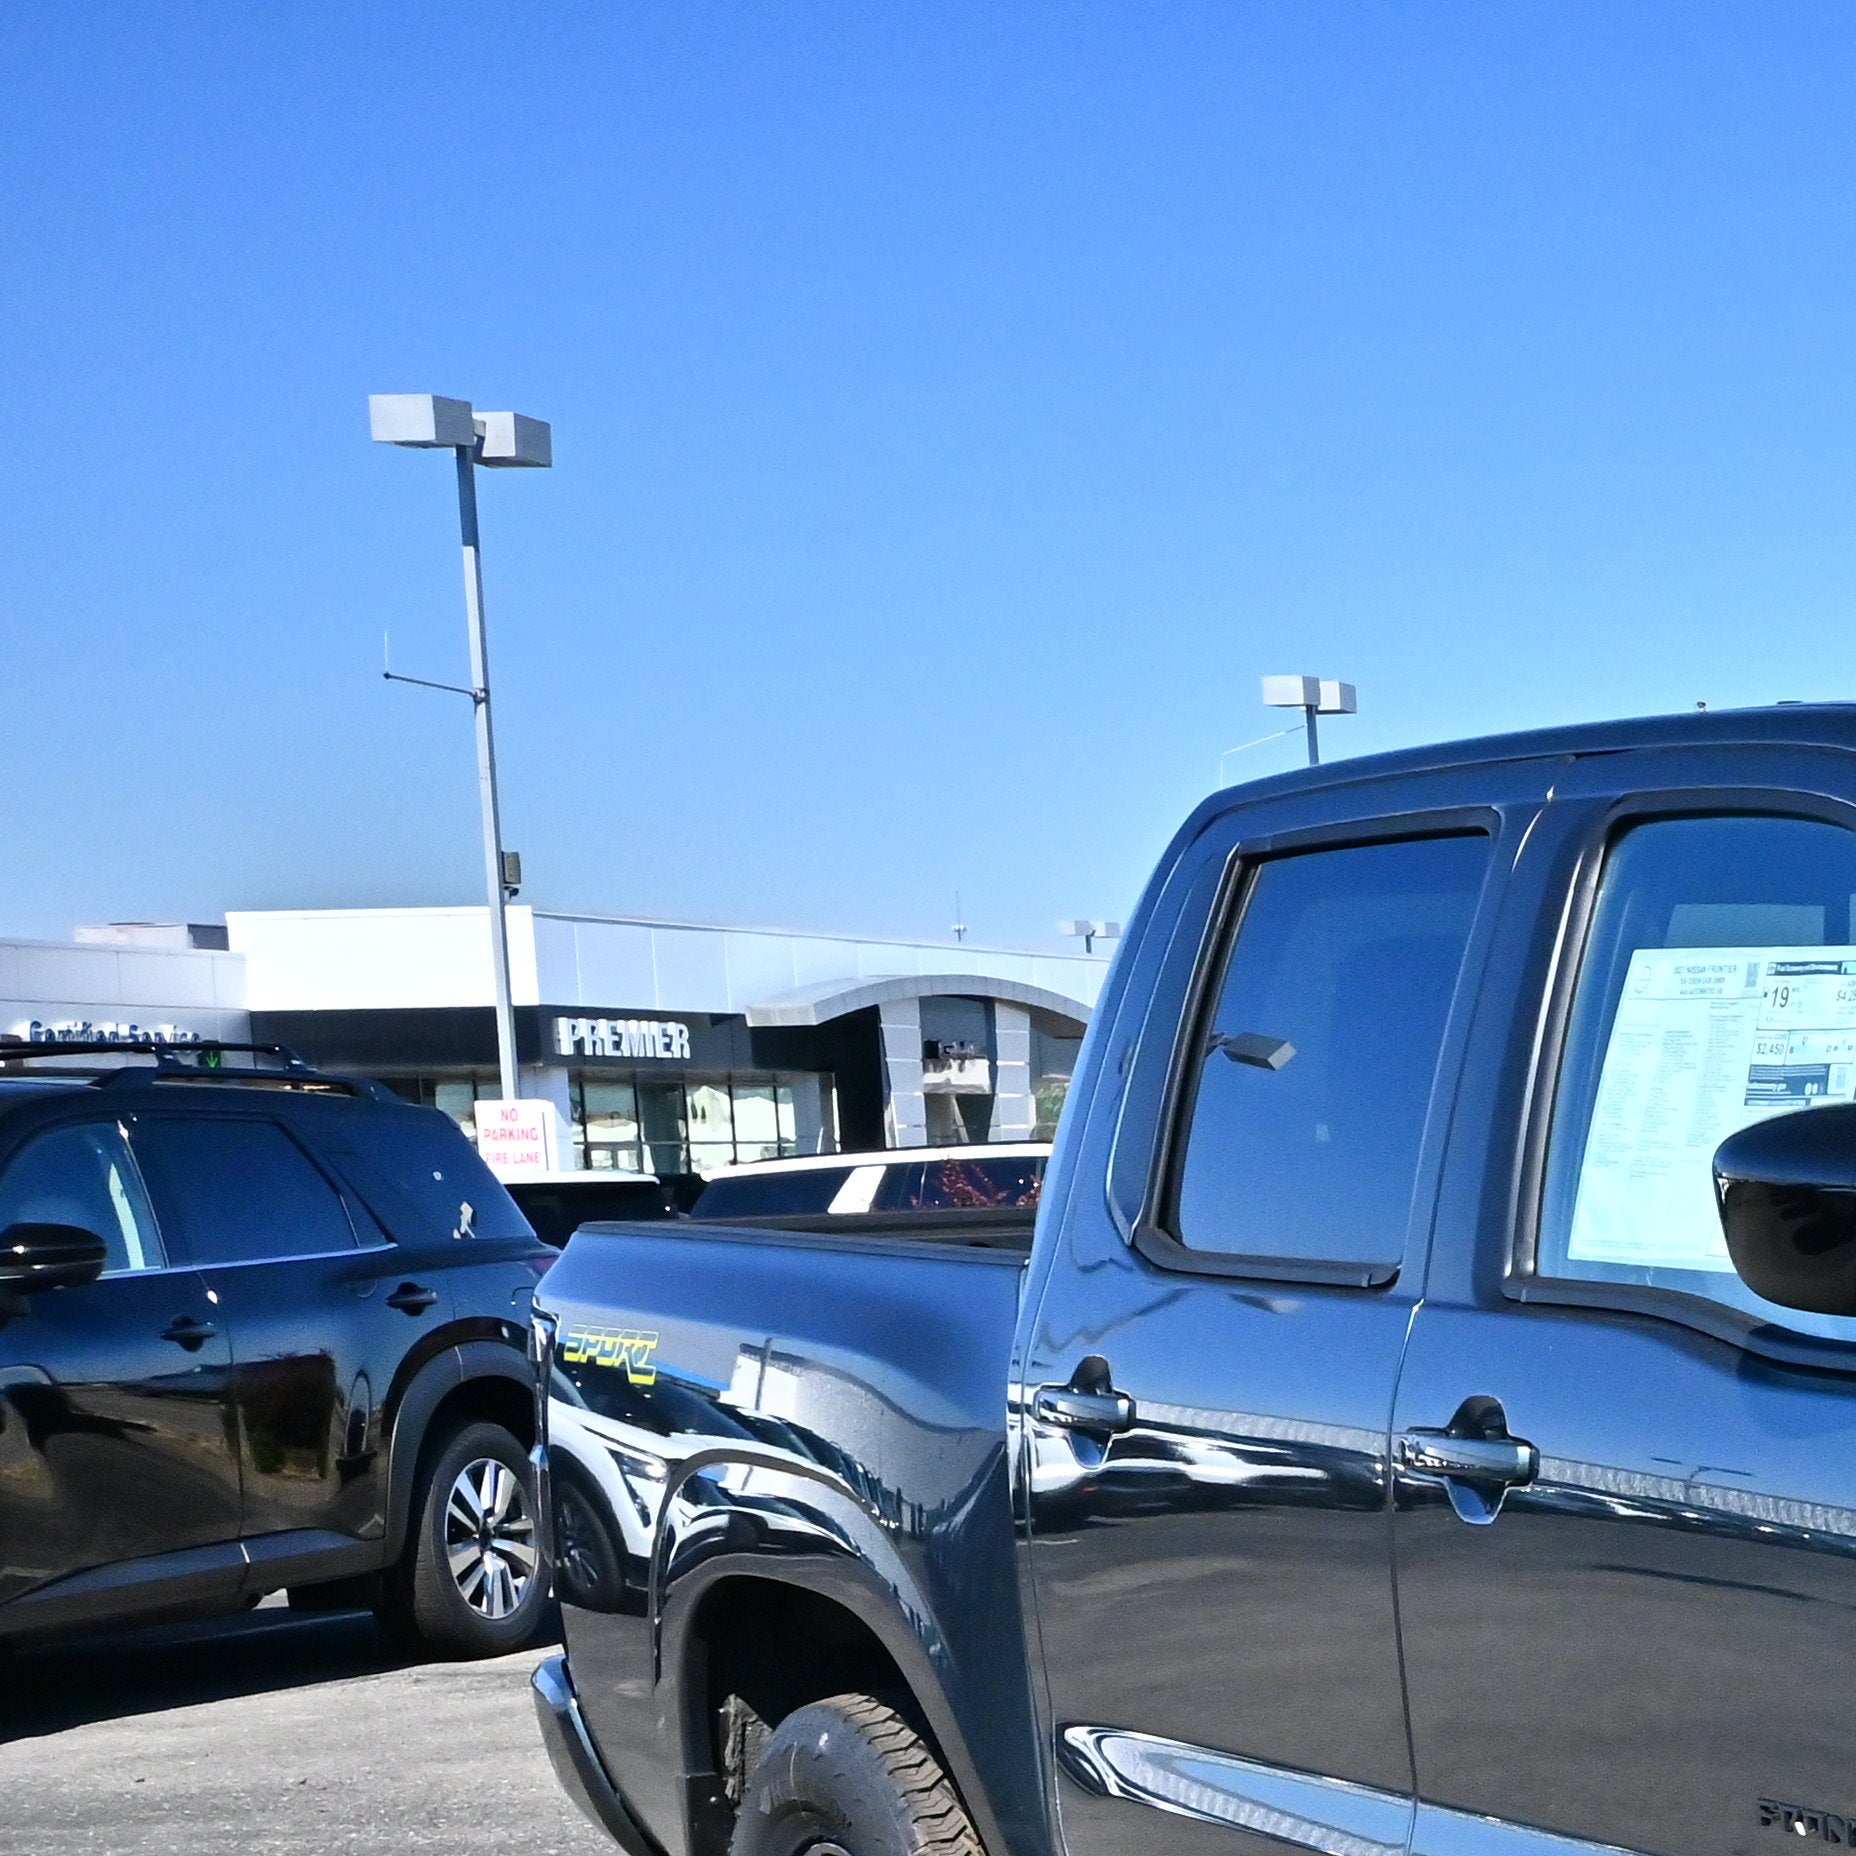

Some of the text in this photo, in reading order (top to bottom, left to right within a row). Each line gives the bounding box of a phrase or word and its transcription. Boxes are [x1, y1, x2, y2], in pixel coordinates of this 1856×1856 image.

[1772, 986, 1790, 1008] 19
[555, 1017, 691, 1059] PREMIER
[501, 1108, 518, 1122] NO
[484, 1127, 538, 1141] PARKING
[486, 1151, 540, 1164] FIRE LANE
